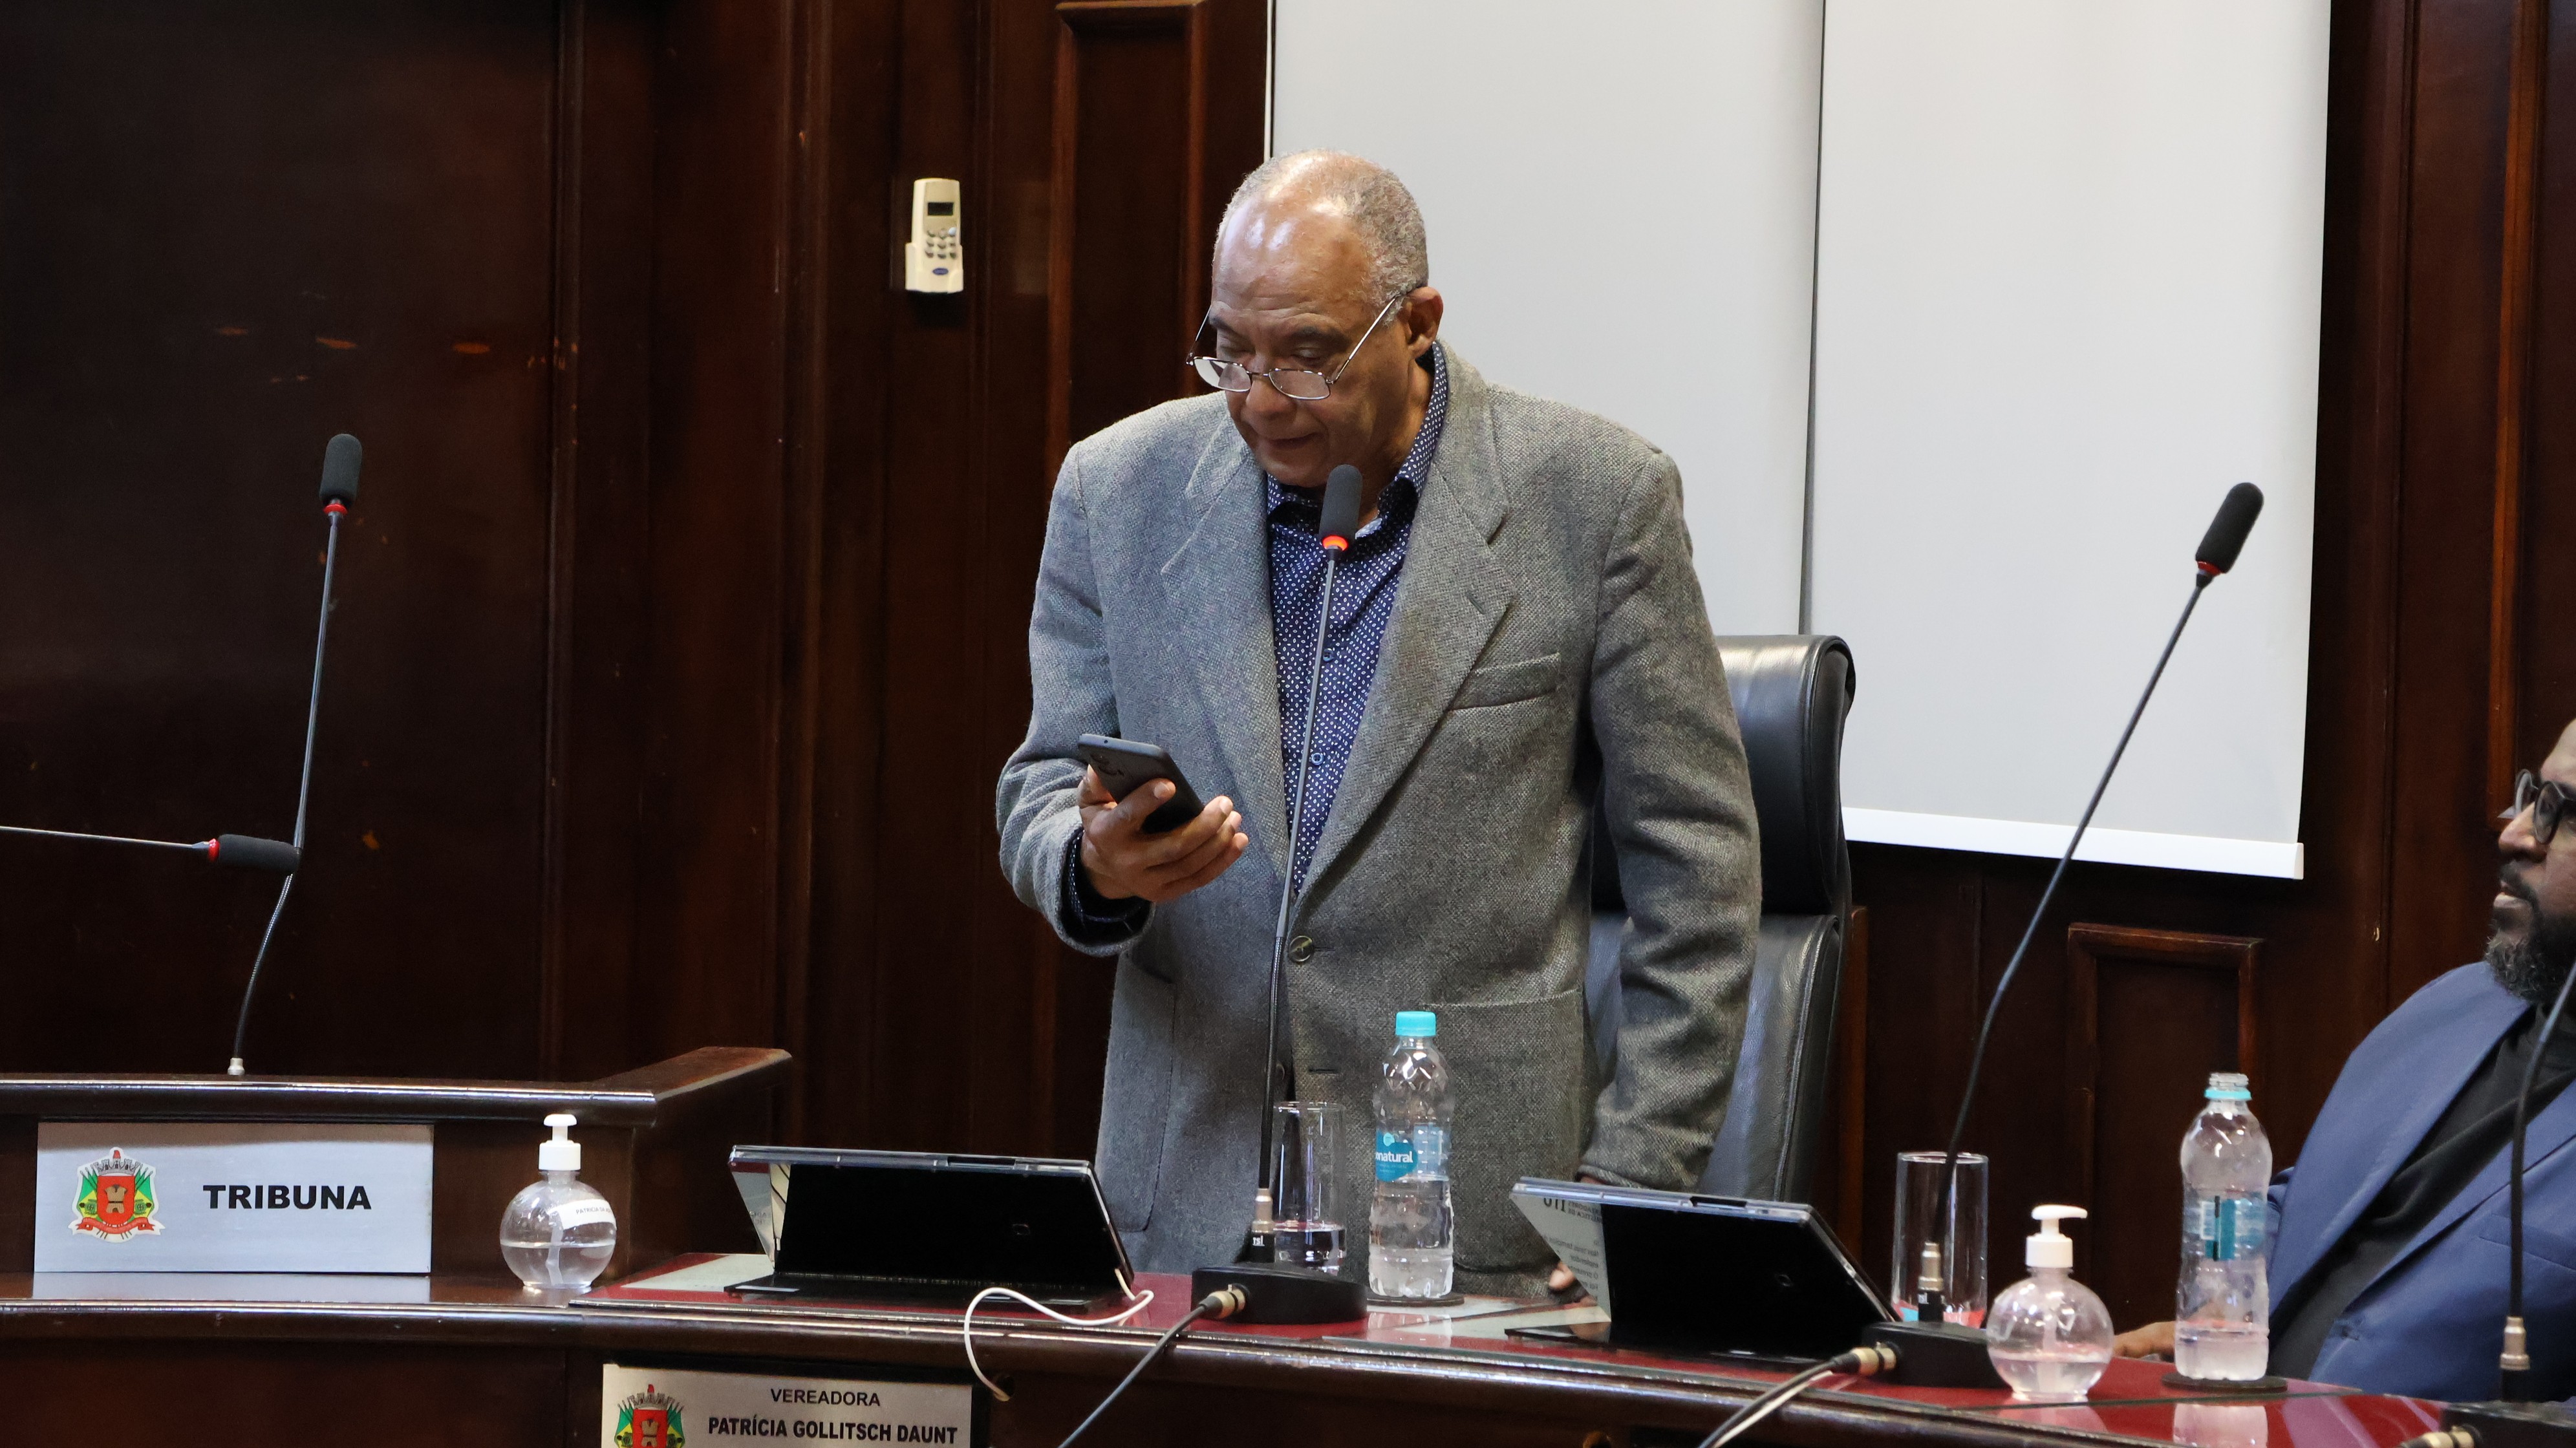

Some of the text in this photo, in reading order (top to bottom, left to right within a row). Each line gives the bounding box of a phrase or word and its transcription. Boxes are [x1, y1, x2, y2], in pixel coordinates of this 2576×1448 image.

[203, 1185, 372, 1209] TRIBUNA
[771, 1389, 880, 1407] VEREADORA
[709, 1414, 958, 1444] PATRÍCIA GOLLITSCH DAUNT
